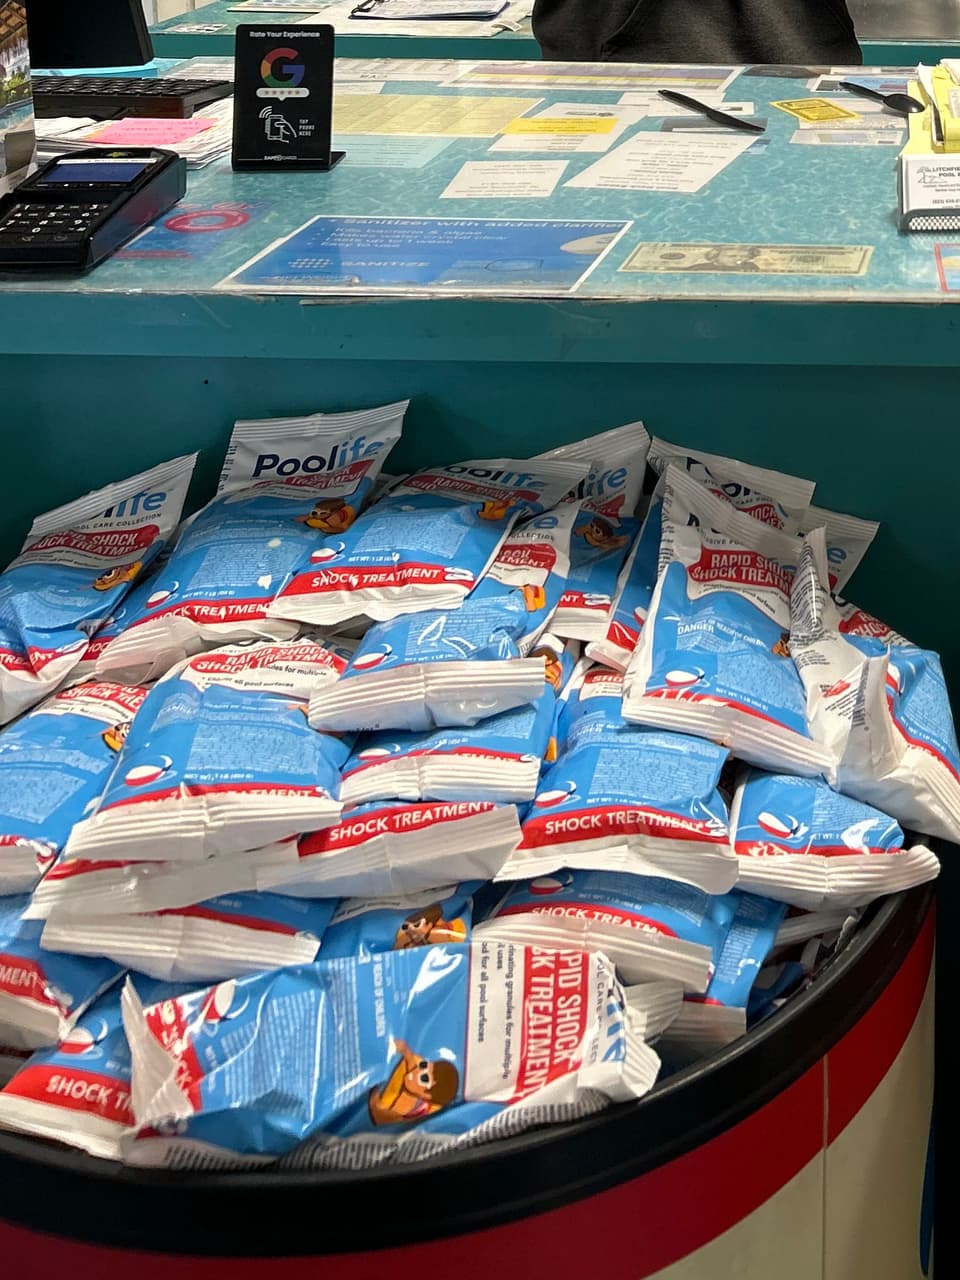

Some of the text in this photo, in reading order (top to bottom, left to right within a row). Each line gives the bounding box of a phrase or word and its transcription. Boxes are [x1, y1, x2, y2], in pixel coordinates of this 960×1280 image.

[267, 31, 282, 39] Your
[252, 436, 385, 478] Poolife
[712, 553, 752, 567] RAPID
[362, 567, 441, 584] TREATMENT
[693, 565, 737, 581] SHOCK
[678, 624, 714, 634] DANGER
[330, 801, 489, 841] SHOCK TREATMENT
[545, 813, 600, 834] SHOCK
[553, 991, 582, 1063] SHOCK
[46, 1074, 113, 1106] SHOCK
